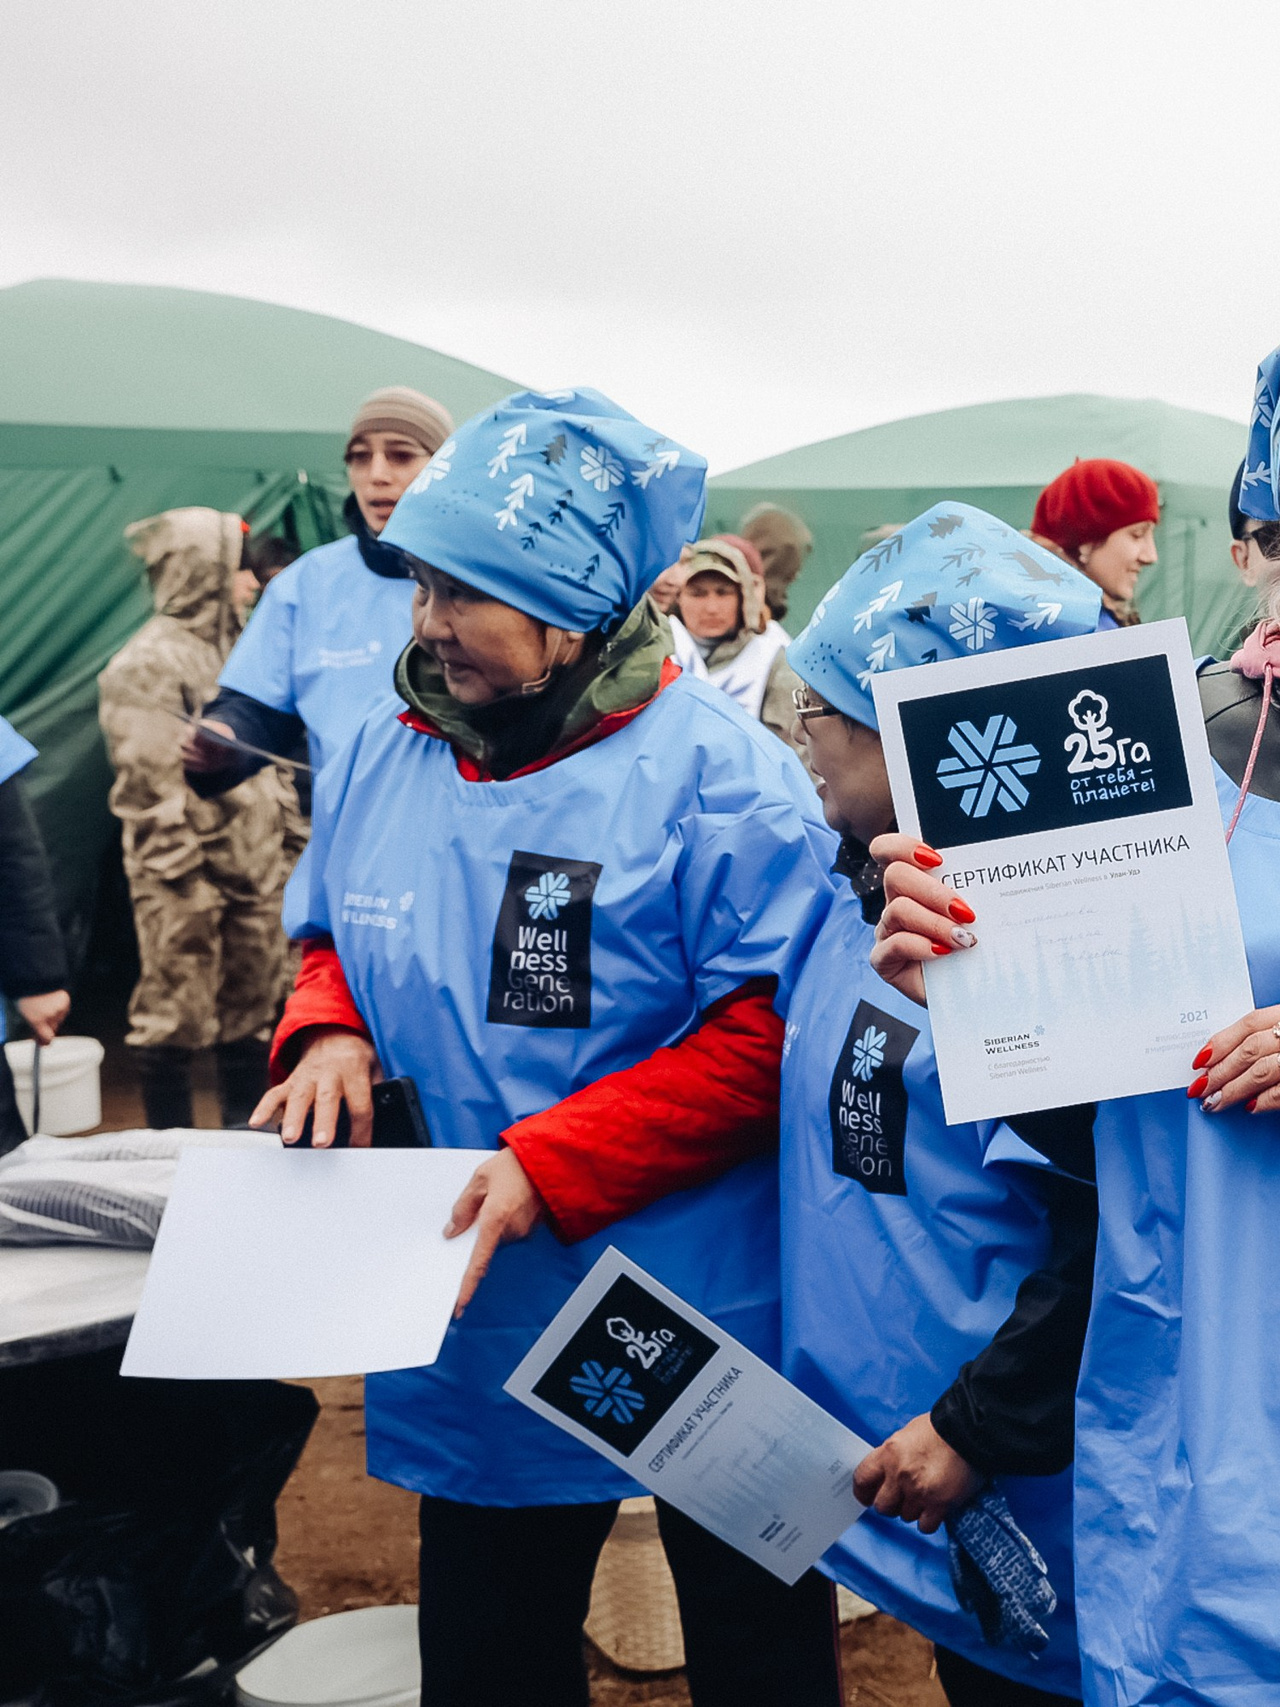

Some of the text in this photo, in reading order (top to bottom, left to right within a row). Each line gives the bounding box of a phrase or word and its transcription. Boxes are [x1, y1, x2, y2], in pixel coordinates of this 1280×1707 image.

[1070, 777, 1091, 791] от
[1096, 767, 1136, 784] тебя
[1072, 778, 1156, 805] планете!
[941, 834, 1191, 890] СЕРТИФИКАТ УЧАСТНИКА
[1109, 869, 1141, 879] Улан-Удэ
[518, 926, 568, 952] Well
[510, 950, 568, 972] ness
[1180, 1009, 1208, 1024] 2021
[984, 1033, 1030, 1047] SIBERIAN
[985, 1041, 1040, 1055] WELLNESS
[842, 1079, 881, 1116] Well
[839, 1106, 883, 1134] ness
[648, 1416, 698, 1473] СЕРТИФИКАТ
[691, 1366, 744, 1421] УЧАСТНИКА
